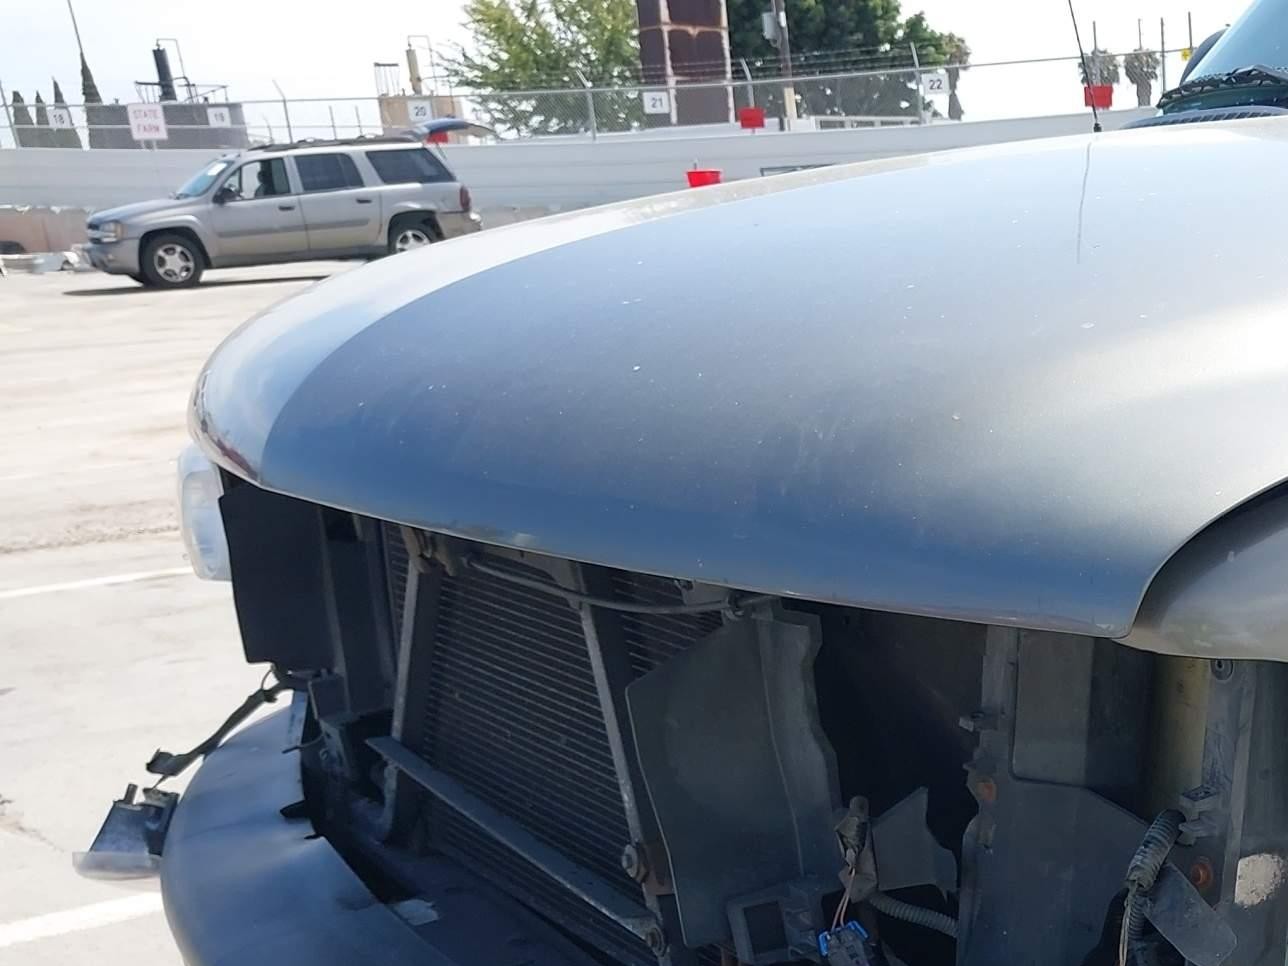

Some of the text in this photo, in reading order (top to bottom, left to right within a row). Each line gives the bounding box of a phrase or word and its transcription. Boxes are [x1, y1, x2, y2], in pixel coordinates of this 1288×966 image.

[929, 79, 943, 90] 22
[651, 96, 664, 109] 21
[132, 109, 162, 120] STATE
[136, 123, 161, 134] FARM
